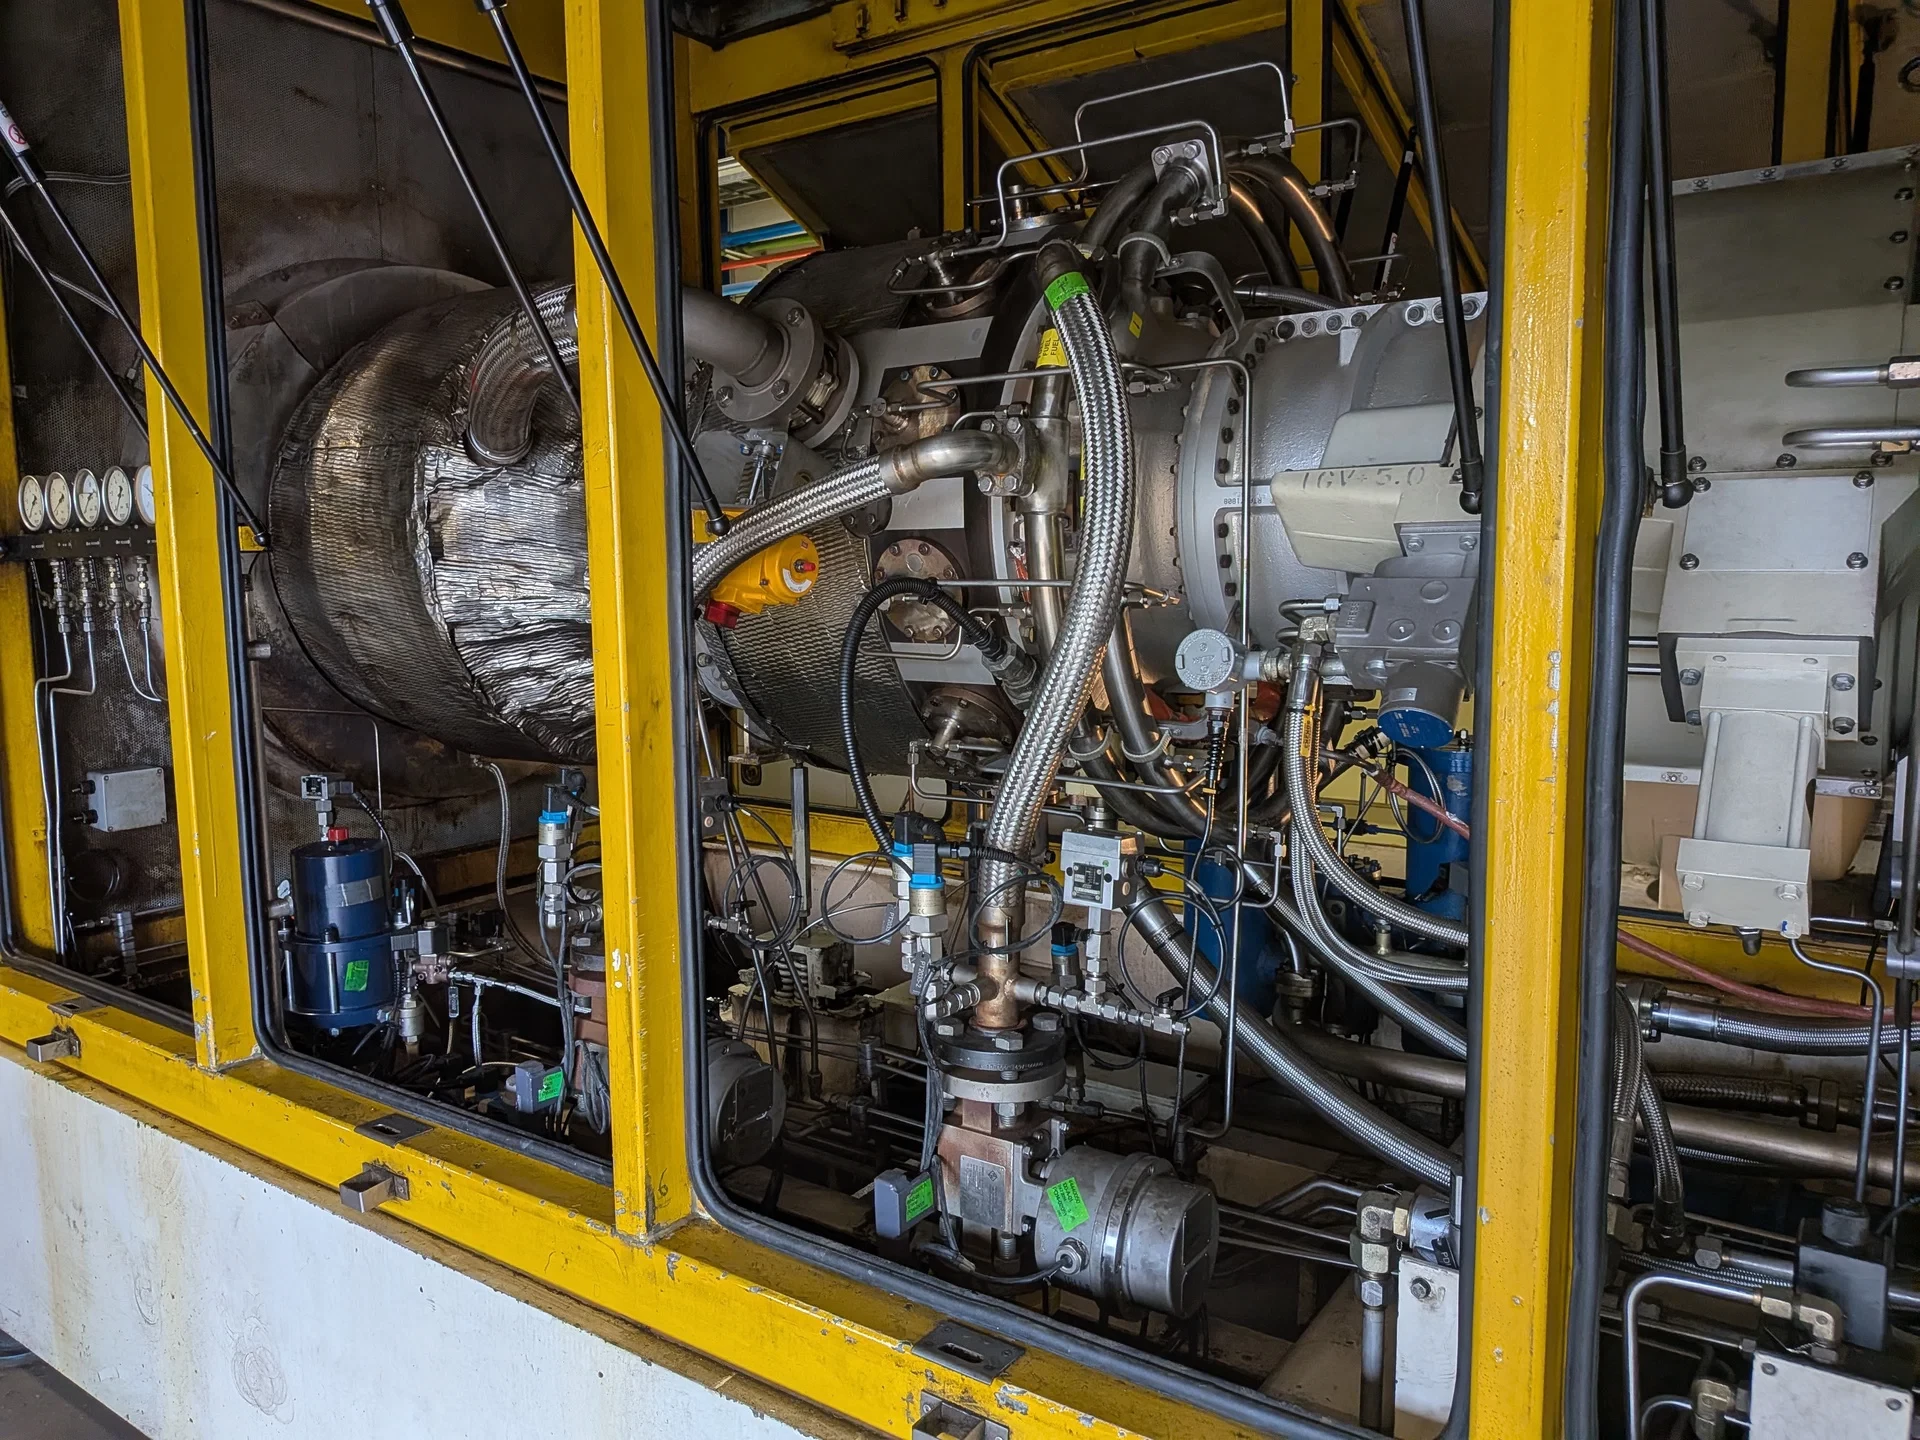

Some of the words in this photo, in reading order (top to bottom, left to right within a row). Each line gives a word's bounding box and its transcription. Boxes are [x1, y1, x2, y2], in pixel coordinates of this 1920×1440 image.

[1043, 337, 1052, 357] FUEL
[1051, 339, 1060, 356] FUEL
[1346, 601, 1360, 628] PRESS
